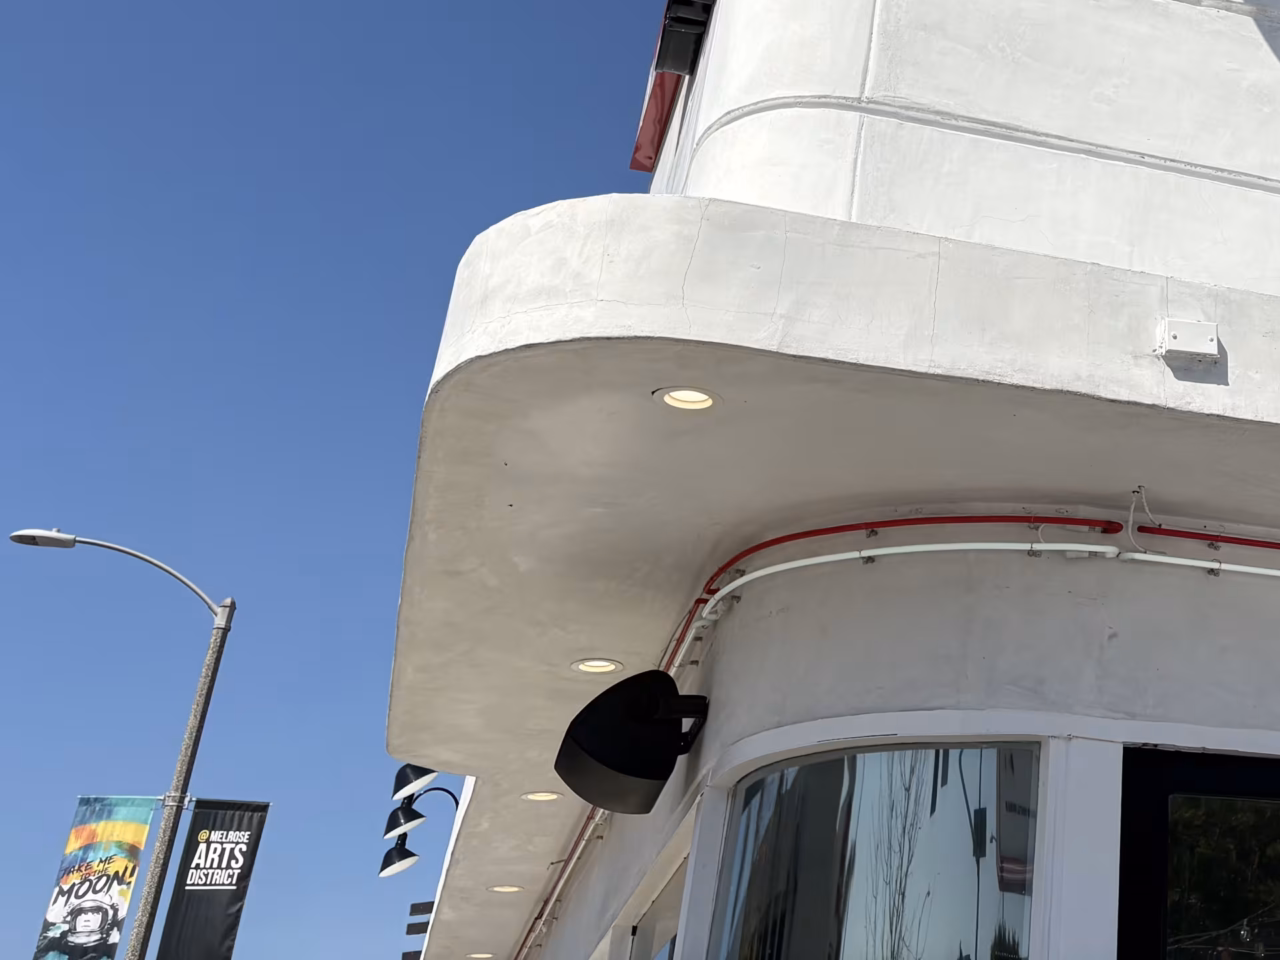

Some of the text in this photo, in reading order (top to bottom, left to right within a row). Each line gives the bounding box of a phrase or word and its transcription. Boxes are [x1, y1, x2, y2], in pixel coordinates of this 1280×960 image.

[210, 831, 251, 842] MELROSE
[97, 853, 117, 867] ME
[191, 843, 247, 868] ARTS
[186, 869, 241, 885] DISTRICT
[52, 864, 137, 907] MOON!
